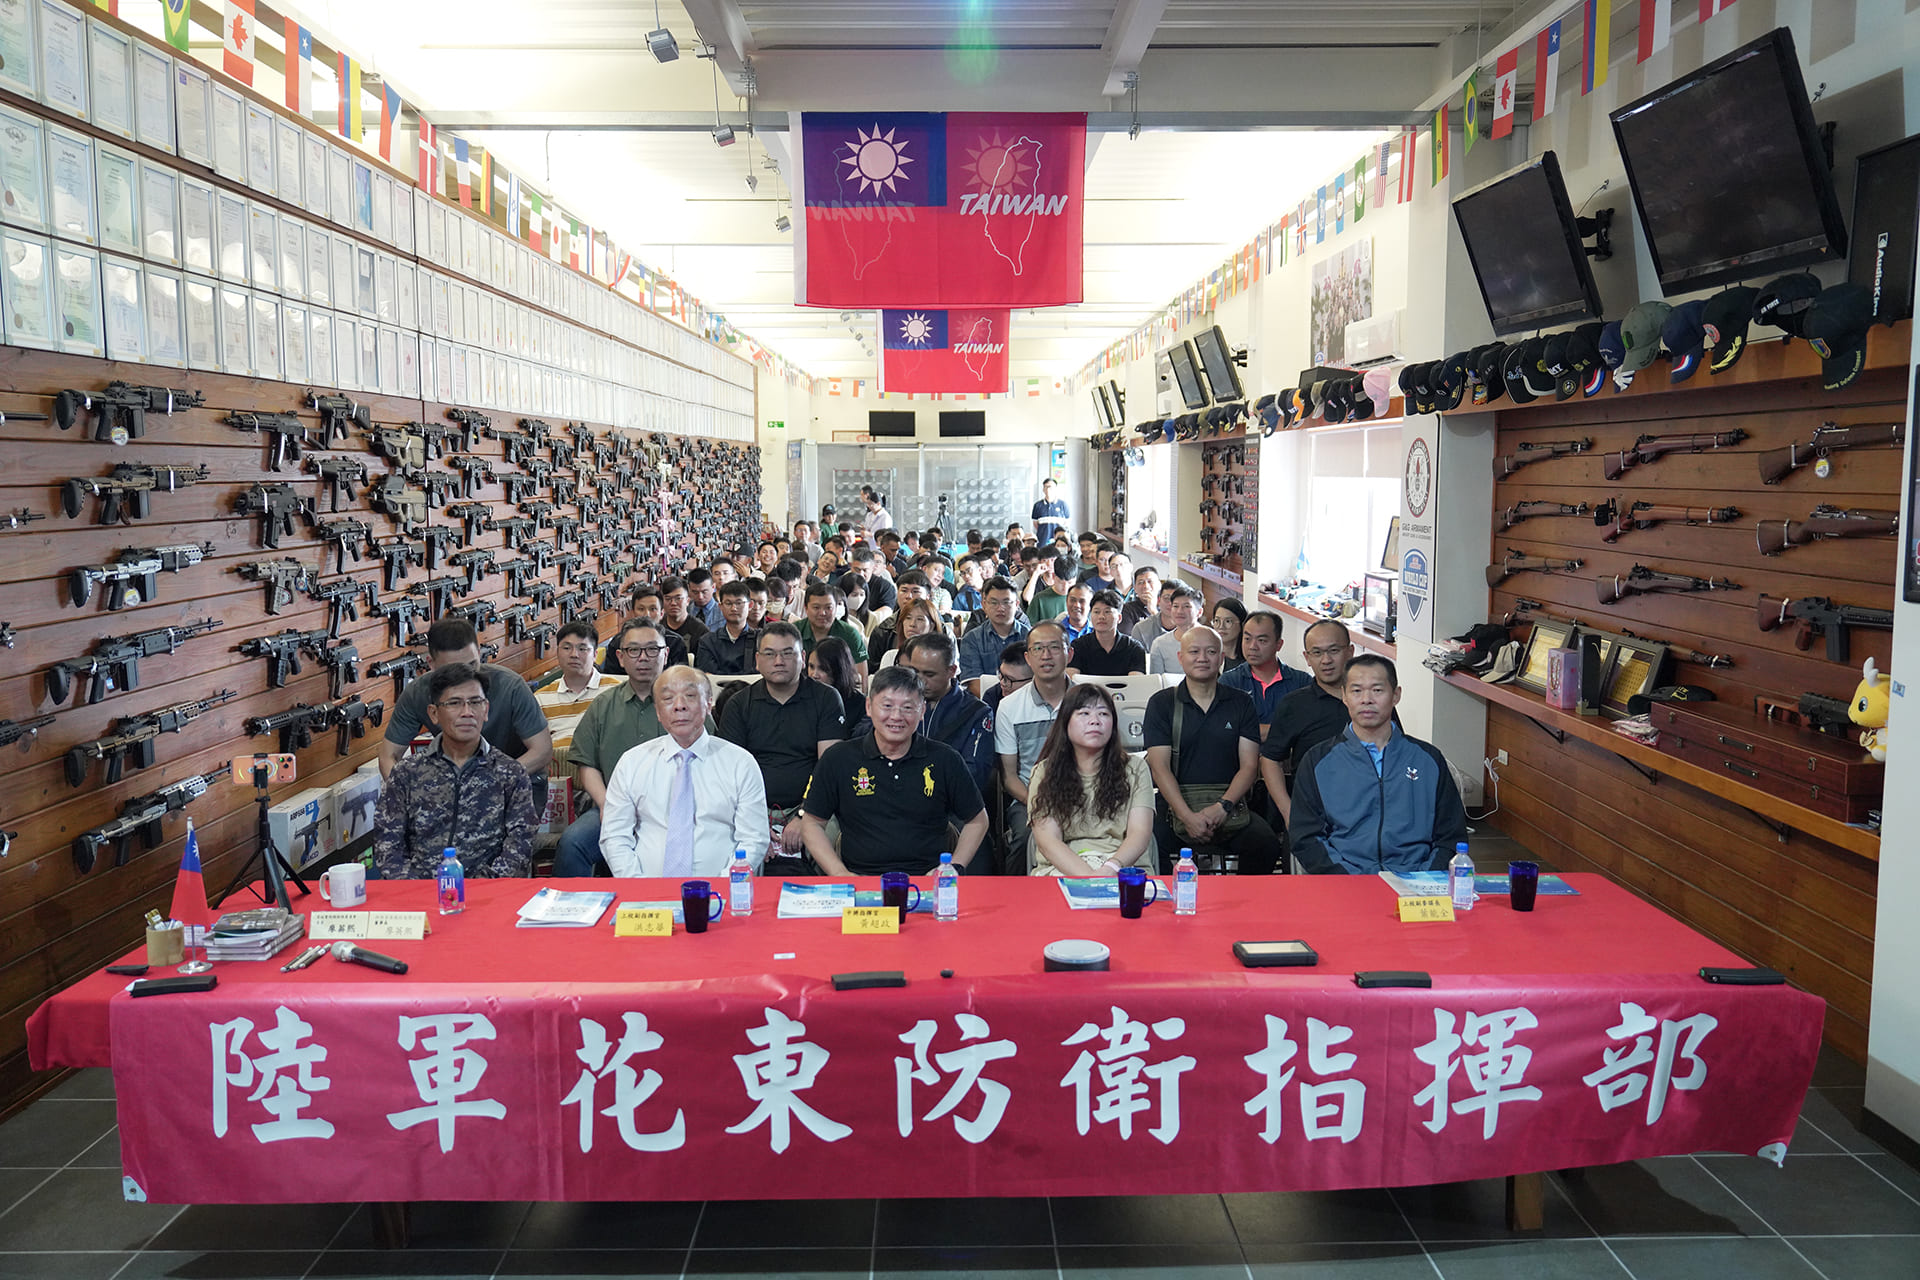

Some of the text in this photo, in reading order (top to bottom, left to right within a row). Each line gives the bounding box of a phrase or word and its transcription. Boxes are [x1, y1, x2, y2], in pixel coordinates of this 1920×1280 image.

[959, 192, 1069, 217] TAIWAN
[953, 342, 1005, 355] TAIWAN
[441, 878, 456, 889] FIJI
[210, 1002, 1718, 1155] 陸軍花東防衛指揮部
